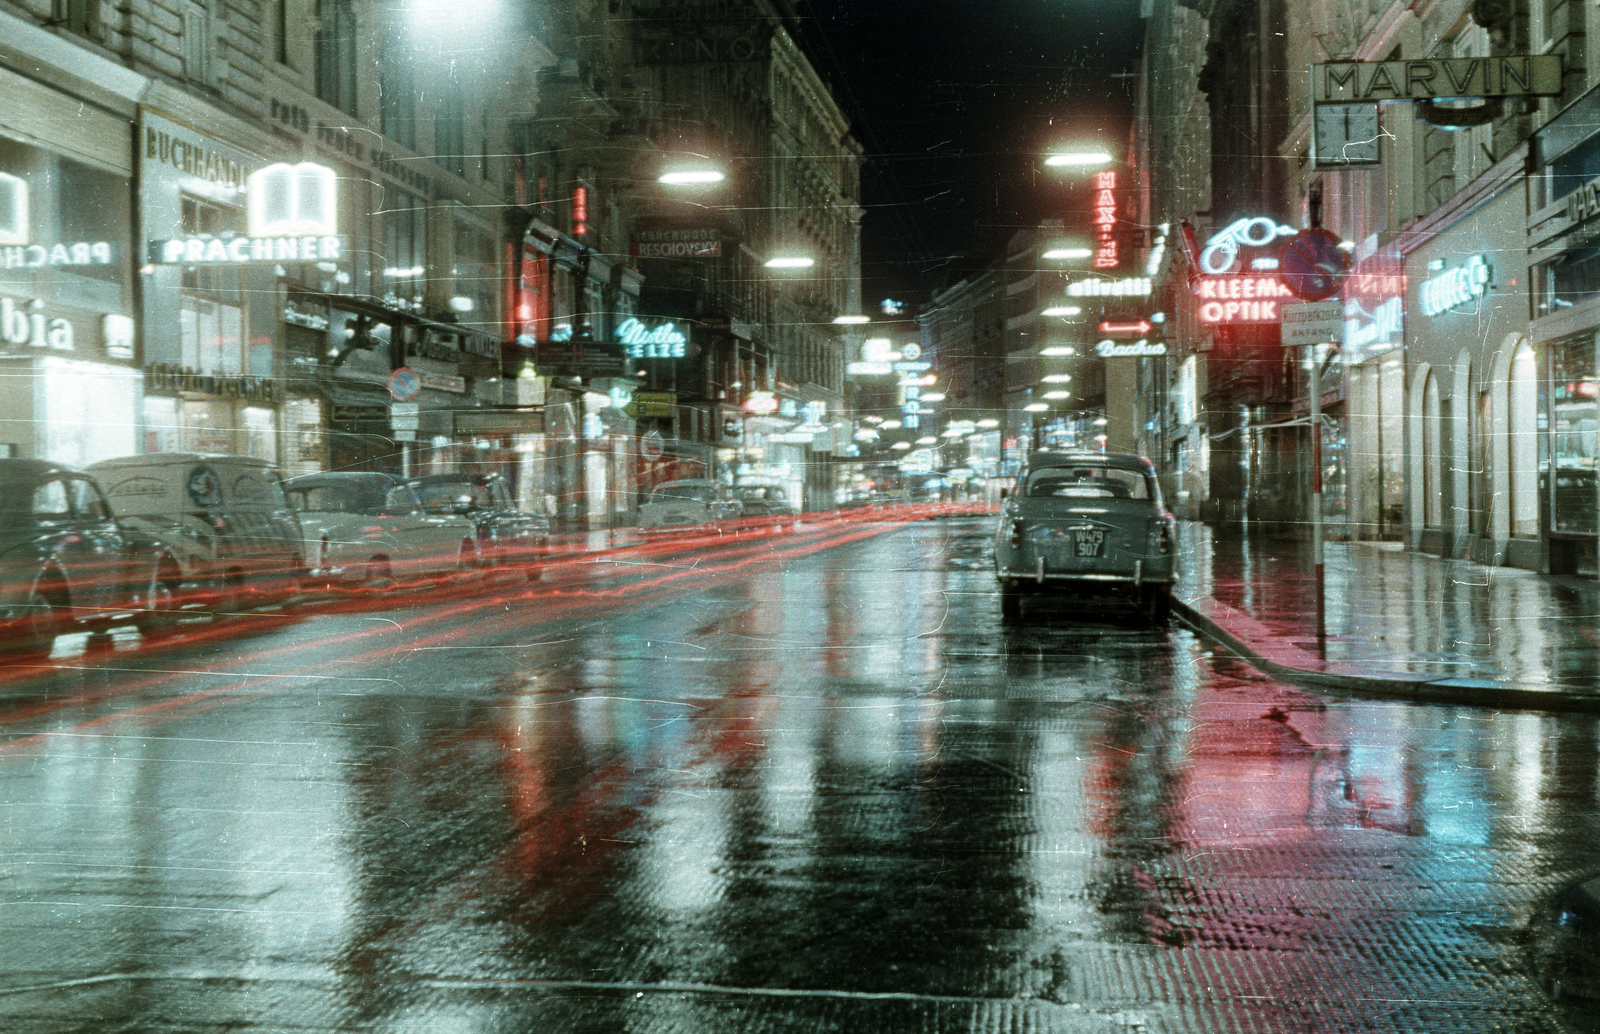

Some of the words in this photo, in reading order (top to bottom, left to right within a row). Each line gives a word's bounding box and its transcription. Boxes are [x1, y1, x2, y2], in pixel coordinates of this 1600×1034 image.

[1323, 58, 1530, 99] MARVIN
[163, 236, 341, 263] PRACHNER
[638, 241, 718, 257] RESCHOVSKY
[1200, 301, 1276, 322] OPTIK
[1292, 328, 1333, 338] ANFANG
[1095, 339, 1167, 357] Bacchus
[1078, 542, 1099, 556] 907
